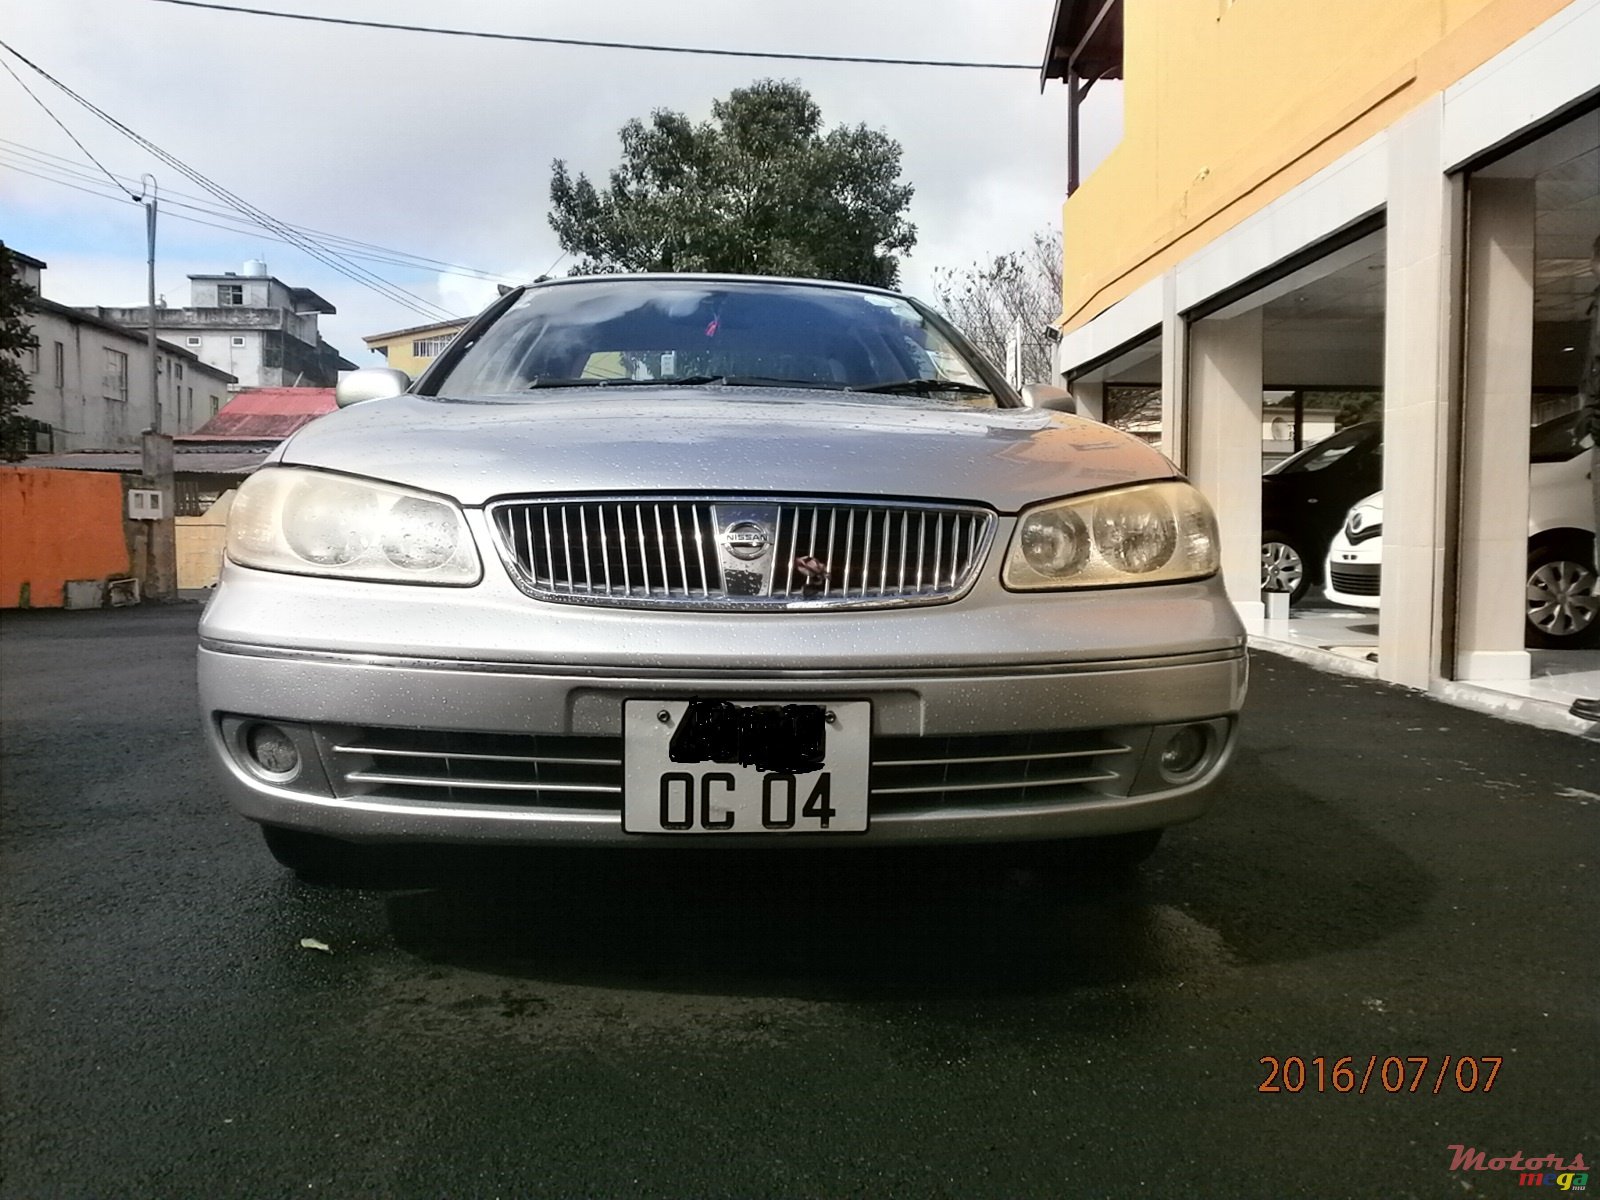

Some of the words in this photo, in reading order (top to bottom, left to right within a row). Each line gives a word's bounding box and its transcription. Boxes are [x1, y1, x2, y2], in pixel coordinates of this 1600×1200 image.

[726, 534, 768, 542] NISSAN
[660, 772, 735, 830] OC
[762, 772, 836, 830] 04
